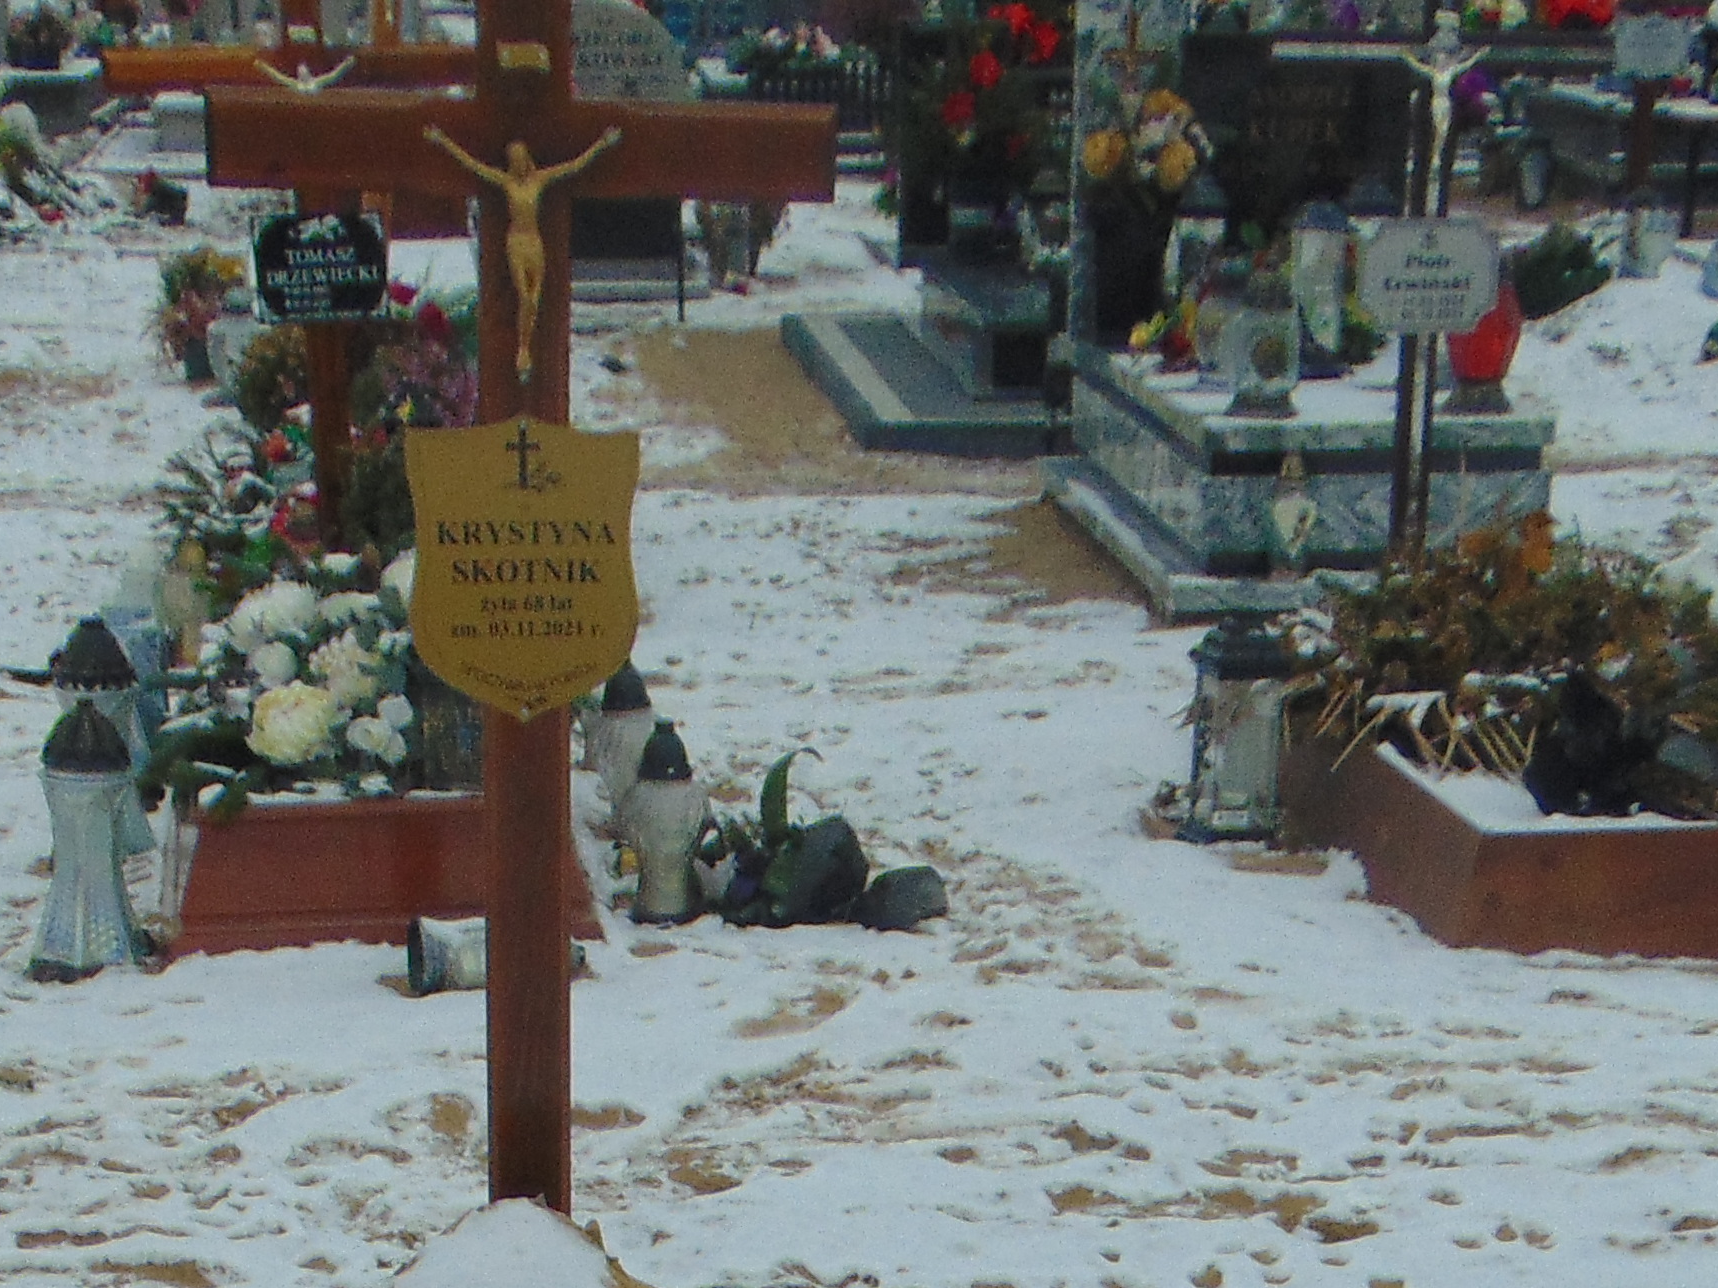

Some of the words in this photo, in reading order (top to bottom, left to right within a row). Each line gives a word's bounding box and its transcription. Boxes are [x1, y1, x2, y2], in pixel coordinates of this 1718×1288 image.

[284, 246, 355, 265] TOMASZ
[266, 265, 379, 285] DRZEWIECKI
[436, 520, 616, 546] KRYSTYNA
[452, 558, 601, 584] SKOTNIK
[550, 595, 573, 612] lat
